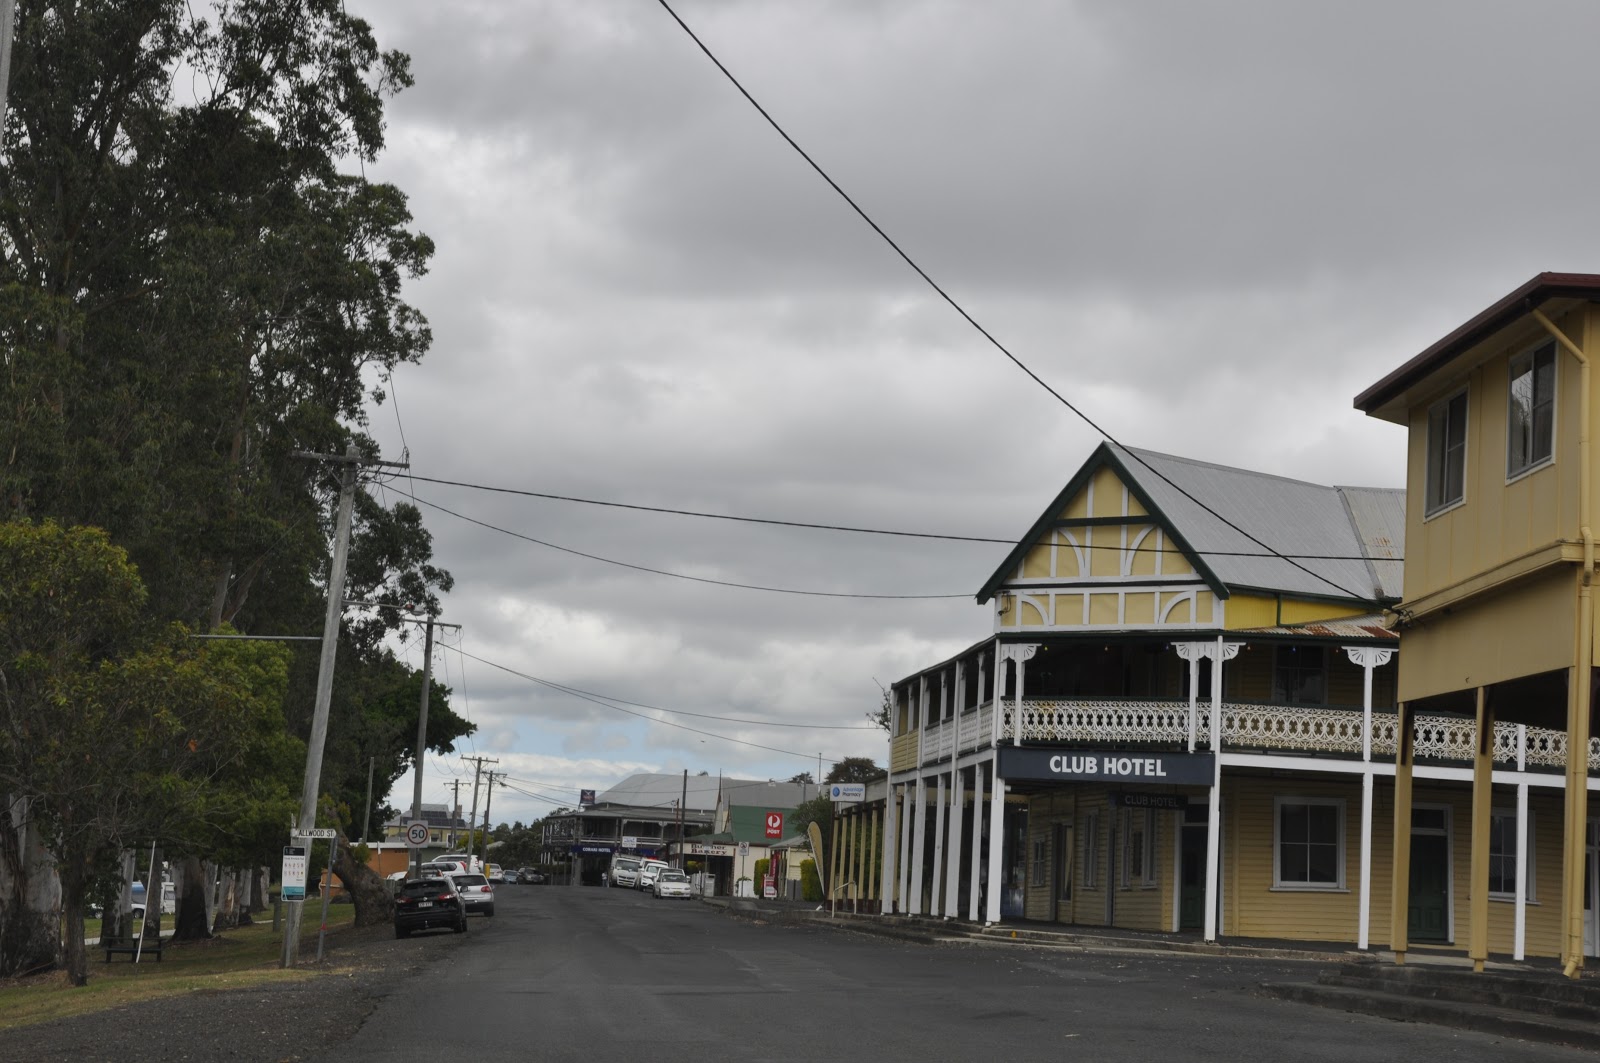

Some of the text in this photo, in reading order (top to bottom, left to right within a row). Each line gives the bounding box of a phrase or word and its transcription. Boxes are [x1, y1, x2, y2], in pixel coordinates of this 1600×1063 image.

[1049, 755, 1167, 777] CLUB HOTEL
[1124, 794, 1179, 807] CLUB HOTEL
[298, 829, 325, 837] ALLWOOD
[411, 829, 425, 839] 50
